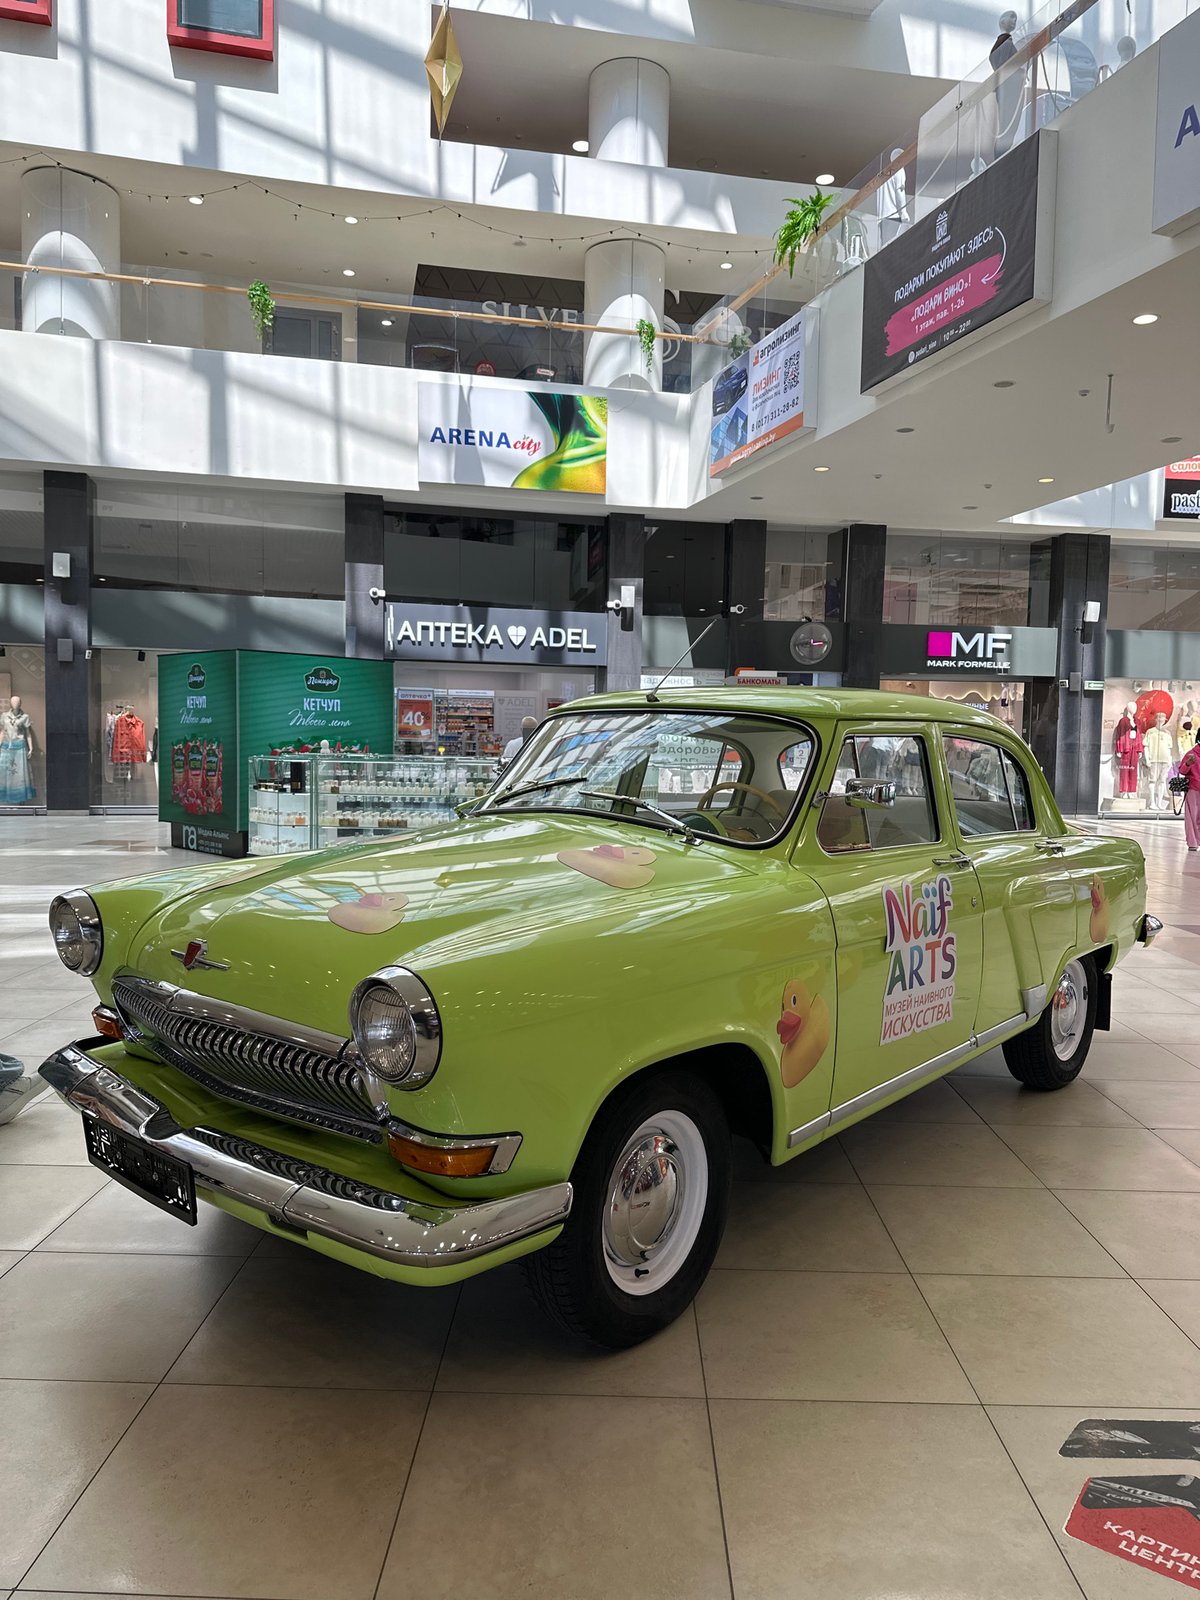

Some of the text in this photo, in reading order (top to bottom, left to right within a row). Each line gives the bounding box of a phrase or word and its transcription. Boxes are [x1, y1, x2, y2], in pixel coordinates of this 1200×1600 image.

[895, 272, 925, 303] ПОДАРКИ
[926, 244, 966, 282] ПОКУПАЮТ
[967, 226, 994, 254] ЗДЕСЬ
[944, 273, 972, 302] ВИНО»!
[481, 301, 584, 333] SILVE
[915, 325, 919, 334] 1
[951, 297, 965, 312] 1-26
[760, 321, 802, 359] агролизинг
[753, 367, 781, 396] ЛИЗИНГ
[430, 427, 541, 456] ARENA city
[1170, 461, 1200, 473] сало
[397, 620, 597, 650] АПТЕКА ADEL
[951, 631, 1013, 658] MF
[927, 660, 1011, 669] MARK FORMELLE
[737, 678, 781, 686] БАНКОМАТЫ
[186, 695, 207, 709] КЕТЧУП
[303, 697, 341, 712] КЕТЧУП
[288, 708, 352, 727] Твоего лета
[660, 746, 721, 755] здоровья
[885, 877, 951, 947] Naïf
[887, 936, 956, 996] ARTS
[885, 985, 954, 1017] МУЗЕЙ НАИВНОГО
[883, 1003, 951, 1041] ИСКУССТВА
